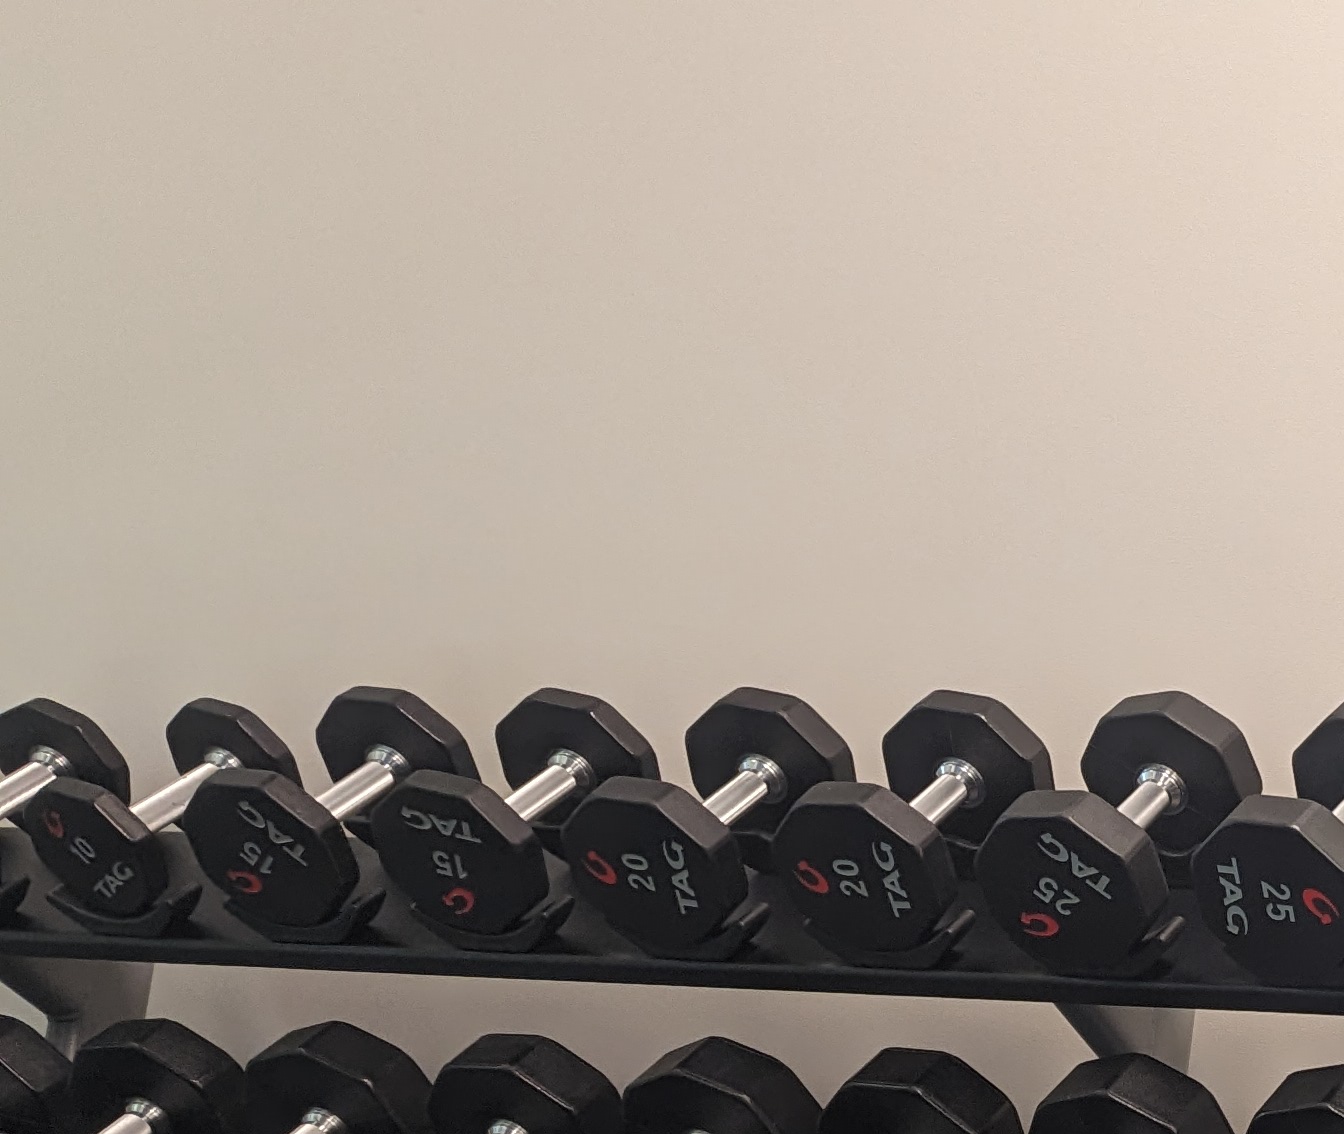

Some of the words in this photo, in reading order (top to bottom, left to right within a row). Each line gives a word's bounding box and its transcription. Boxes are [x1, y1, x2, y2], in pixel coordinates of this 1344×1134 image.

[237, 801, 309, 868] TAG
[402, 807, 481, 843] TAG
[71, 838, 95, 863] 10
[240, 842, 273, 874] 15
[433, 851, 467, 879] 15
[1034, 833, 1112, 900] TAG
[94, 862, 133, 897] TAG
[627, 853, 656, 891] 20
[664, 840, 699, 915] TAG
[833, 860, 868, 896] 20
[872, 842, 911, 917] TAG
[1034, 878, 1080, 915] 25
[1217, 858, 1248, 935] TAG
[1261, 881, 1295, 922] 25
